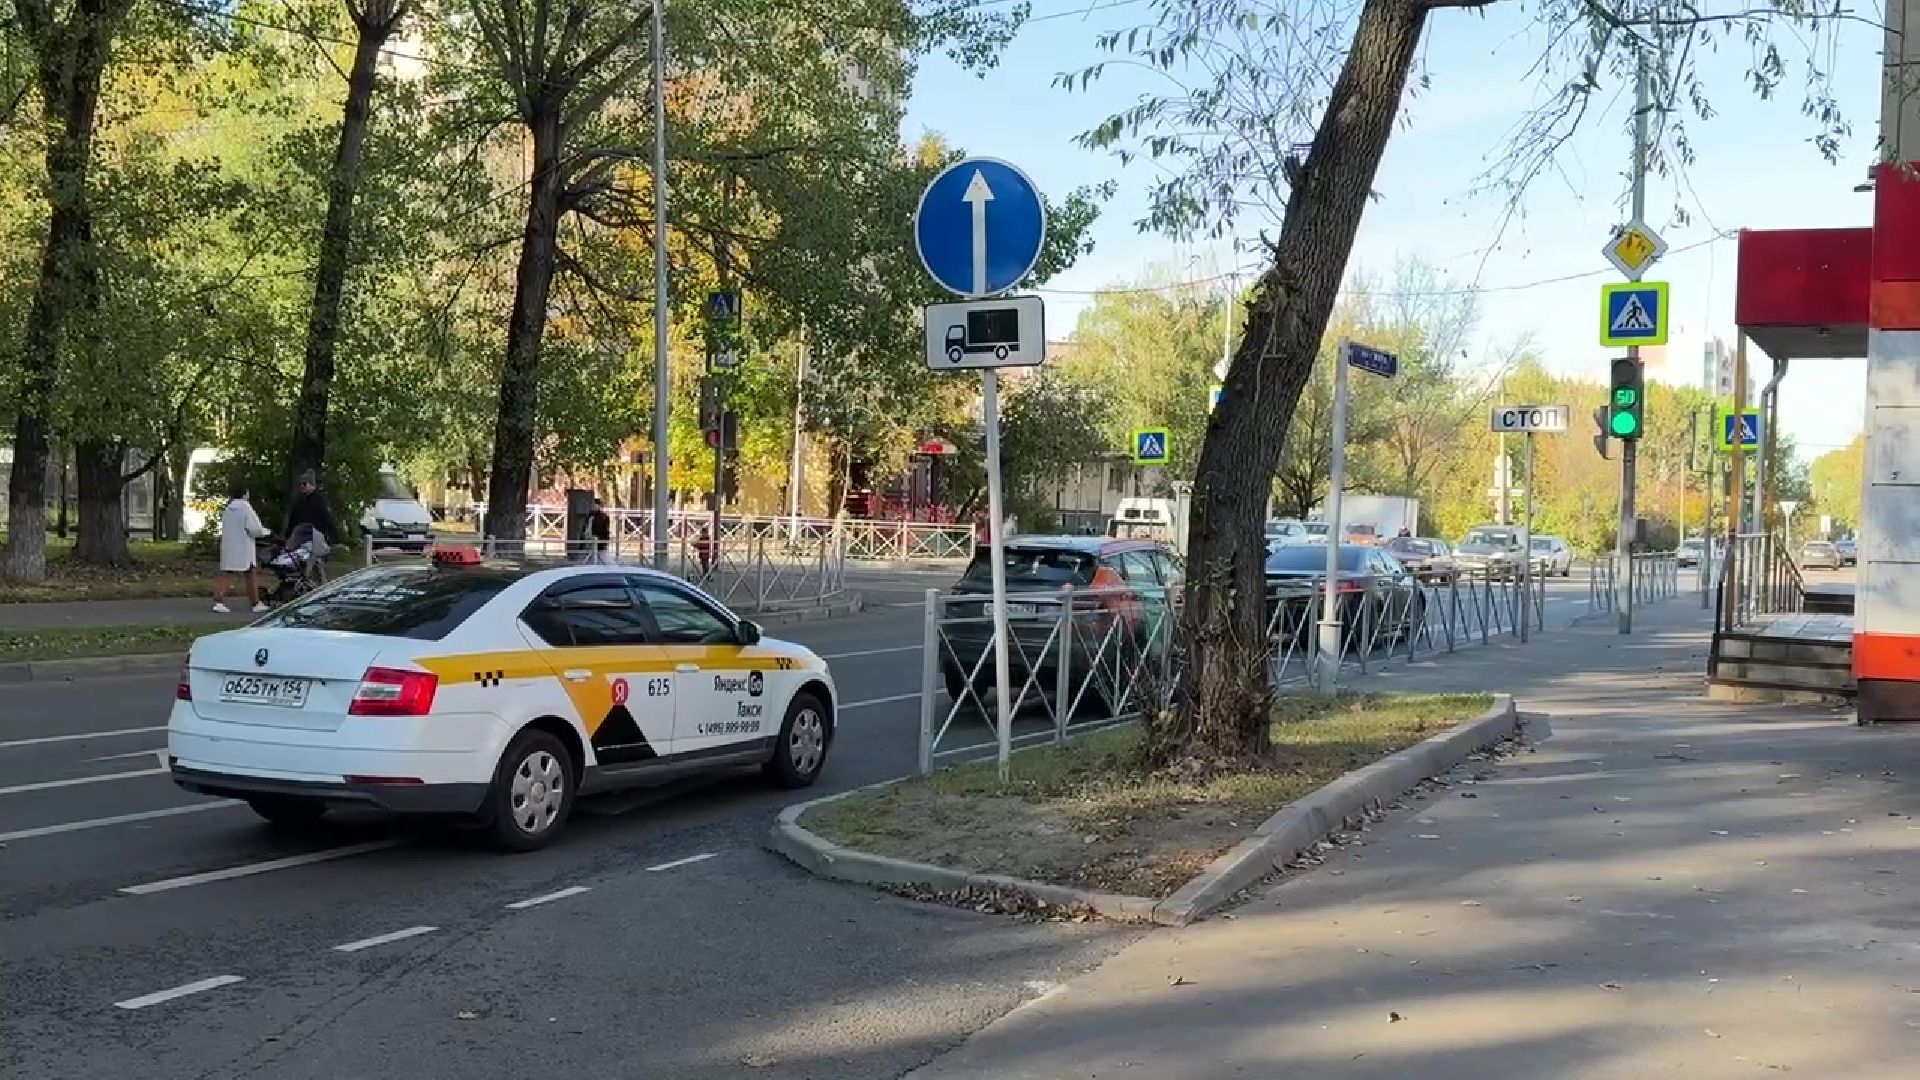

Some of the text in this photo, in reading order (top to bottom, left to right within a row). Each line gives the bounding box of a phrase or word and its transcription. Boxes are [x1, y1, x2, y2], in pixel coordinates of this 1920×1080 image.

[1616, 389, 1636, 404] 50
[1502, 410, 1559, 428] СТОП
[648, 679, 670, 697] 625
[714, 675, 748, 694] Яндекс
[738, 700, 762, 717] Такси
